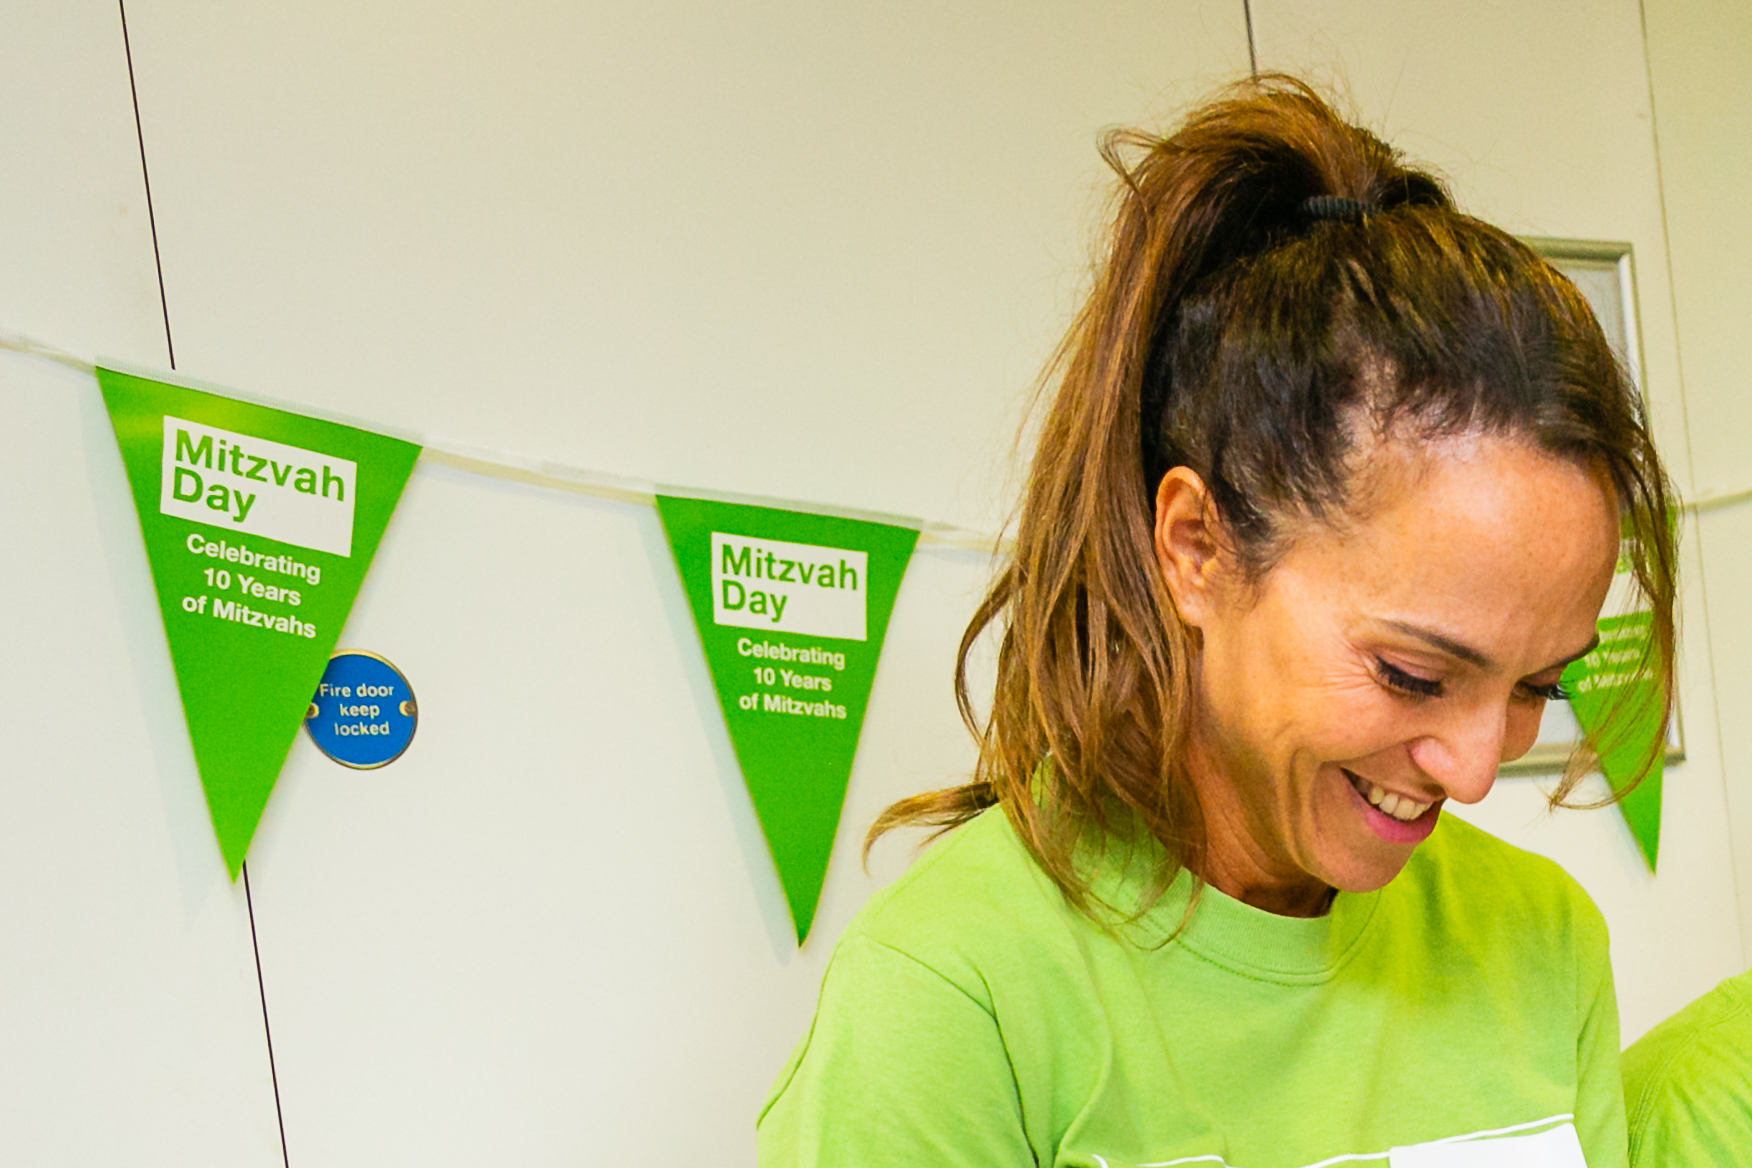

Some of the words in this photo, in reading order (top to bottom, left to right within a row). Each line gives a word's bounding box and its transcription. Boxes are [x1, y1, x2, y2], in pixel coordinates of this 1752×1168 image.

[174, 428, 345, 502] Mitzvah
[172, 467, 256, 523] Day
[186, 533, 321, 586] Celebrating
[721, 543, 858, 591] Mitzvah
[203, 567, 231, 591] 10
[237, 574, 302, 607] Years
[721, 579, 788, 623] Day
[182, 595, 208, 614] of
[212, 599, 317, 639] Mitzvahs
[737, 637, 846, 671] Celebrating
[319, 683, 352, 698] Fire
[356, 682, 394, 698] door
[753, 667, 776, 686] 10
[780, 669, 832, 692] Years
[339, 702, 380, 720] keep
[739, 693, 759, 711] of
[763, 694, 847, 719] Mitzvahs
[334, 720, 391, 737] locked
